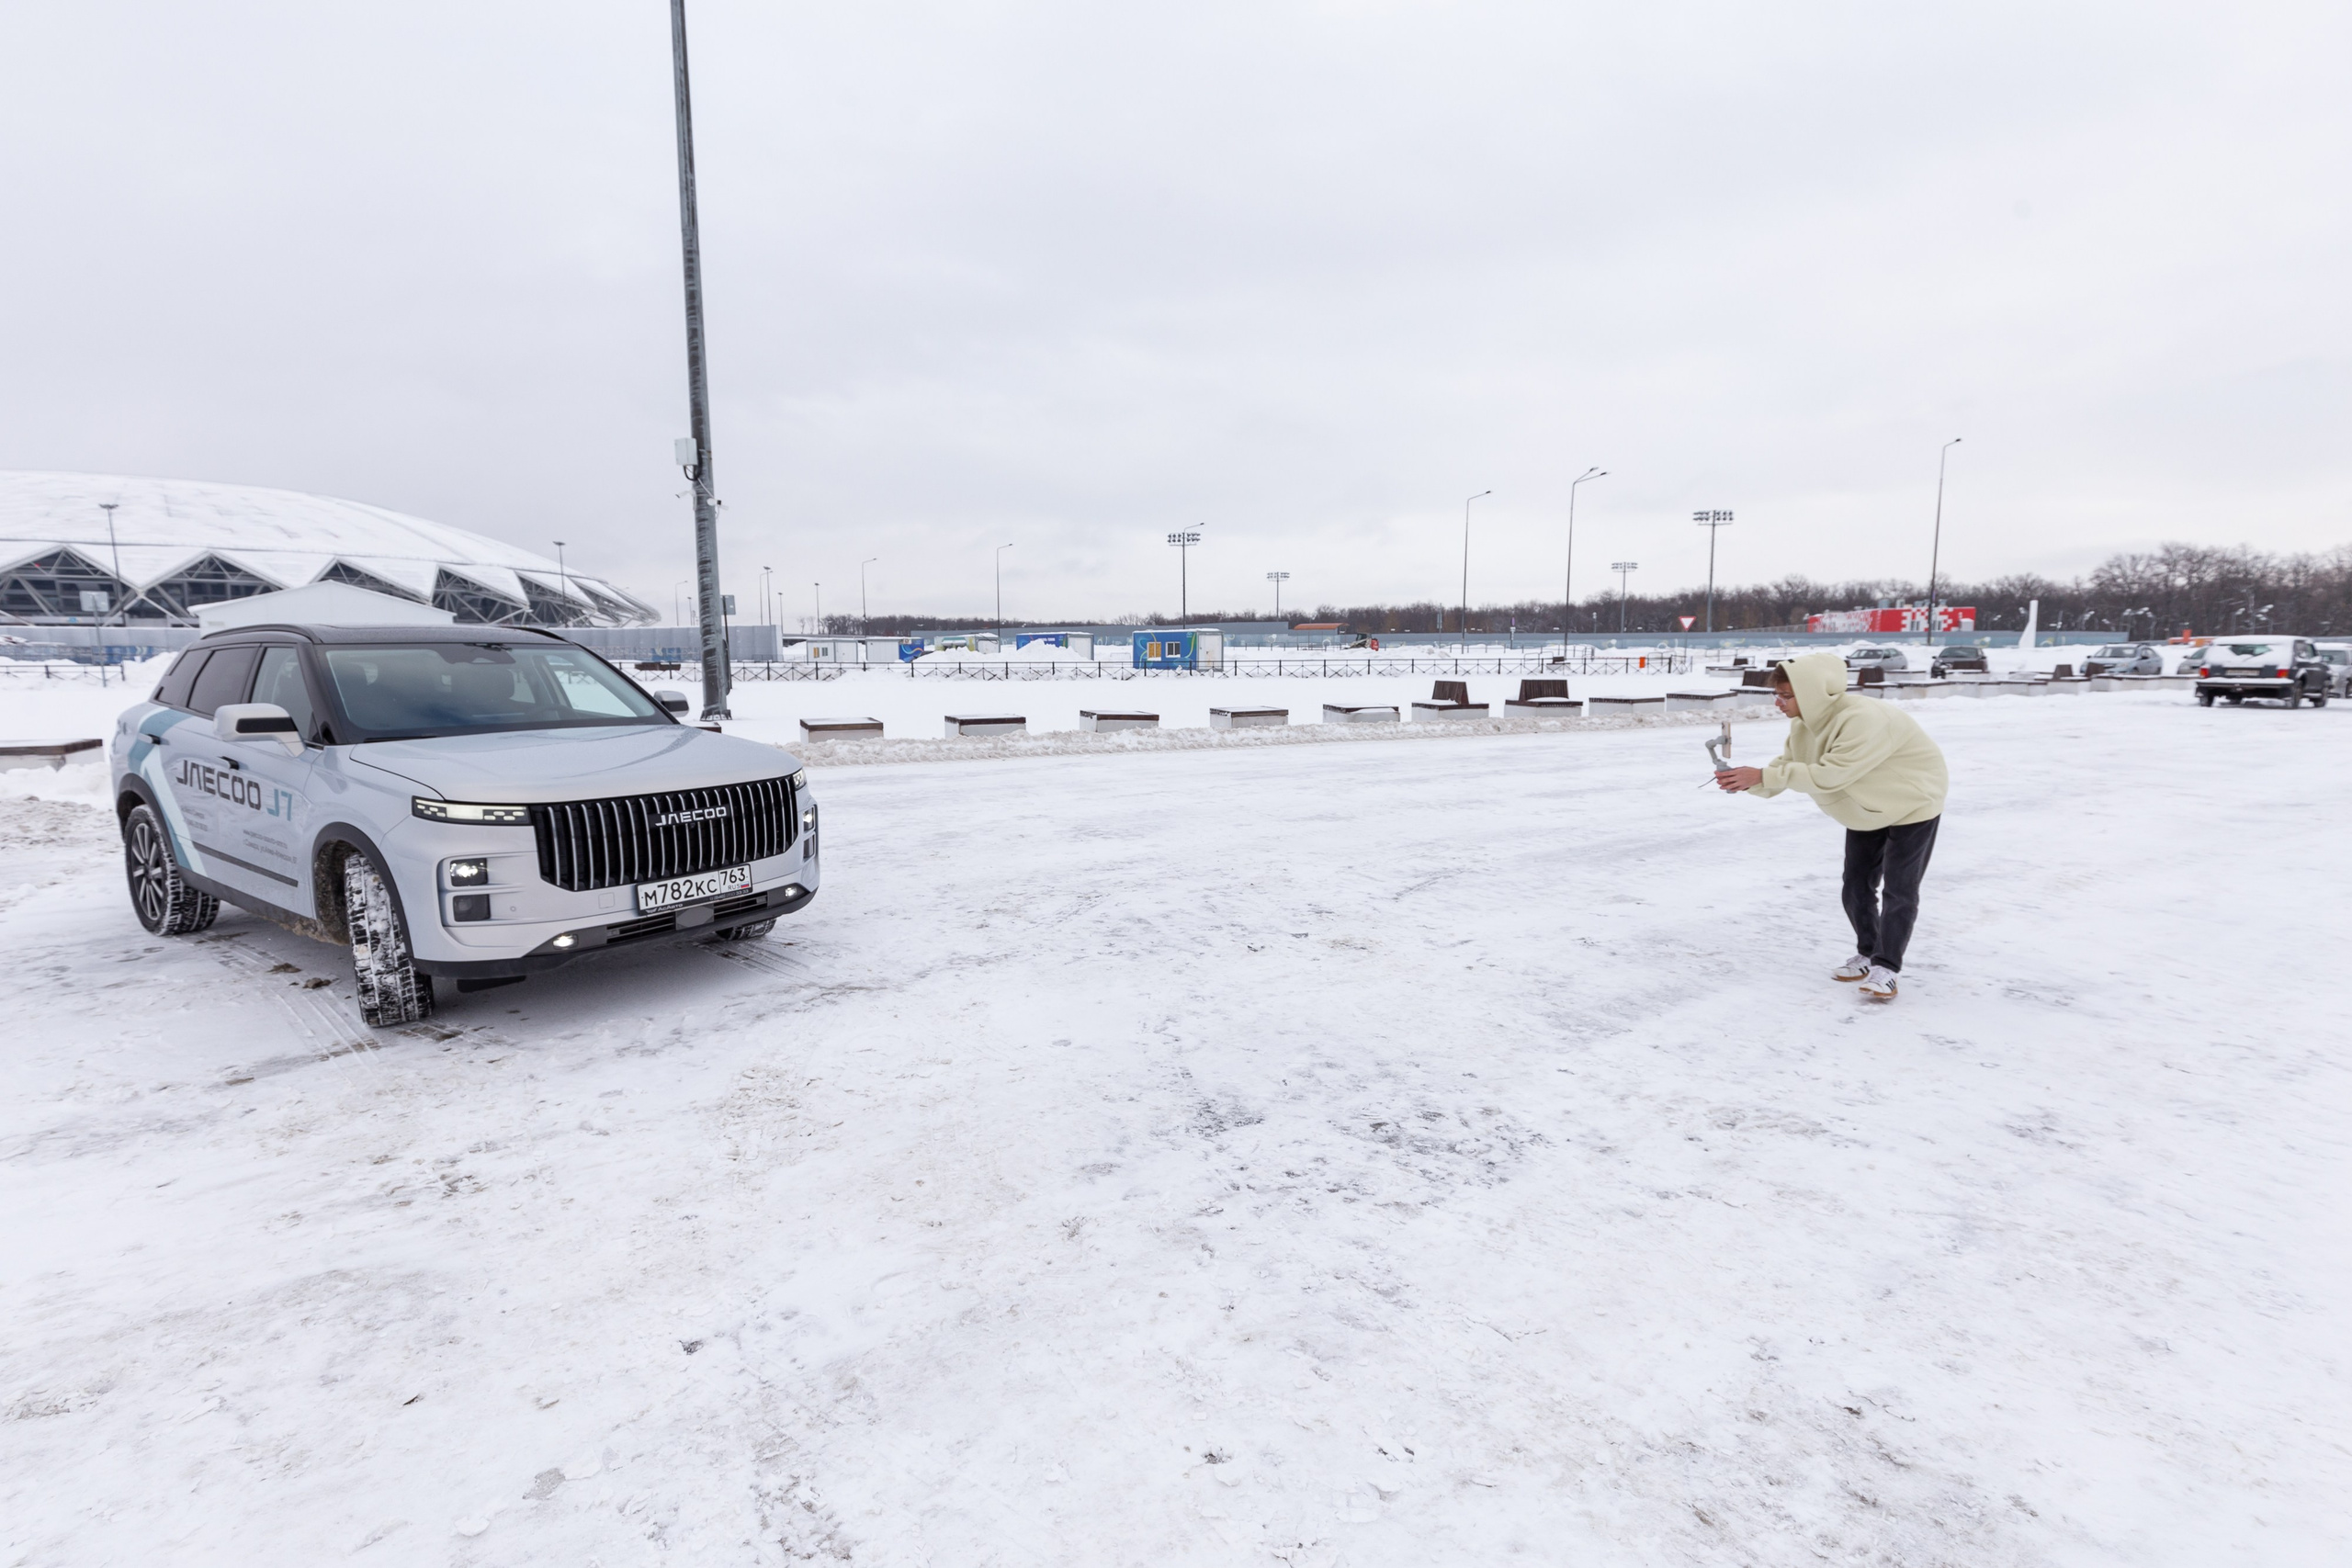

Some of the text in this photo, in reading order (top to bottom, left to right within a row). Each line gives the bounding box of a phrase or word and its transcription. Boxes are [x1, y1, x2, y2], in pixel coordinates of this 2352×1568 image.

[175, 760, 292, 821] JAECOO J7
[655, 807, 727, 826] JAECOO
[644, 867, 745, 907] М782КС 763
